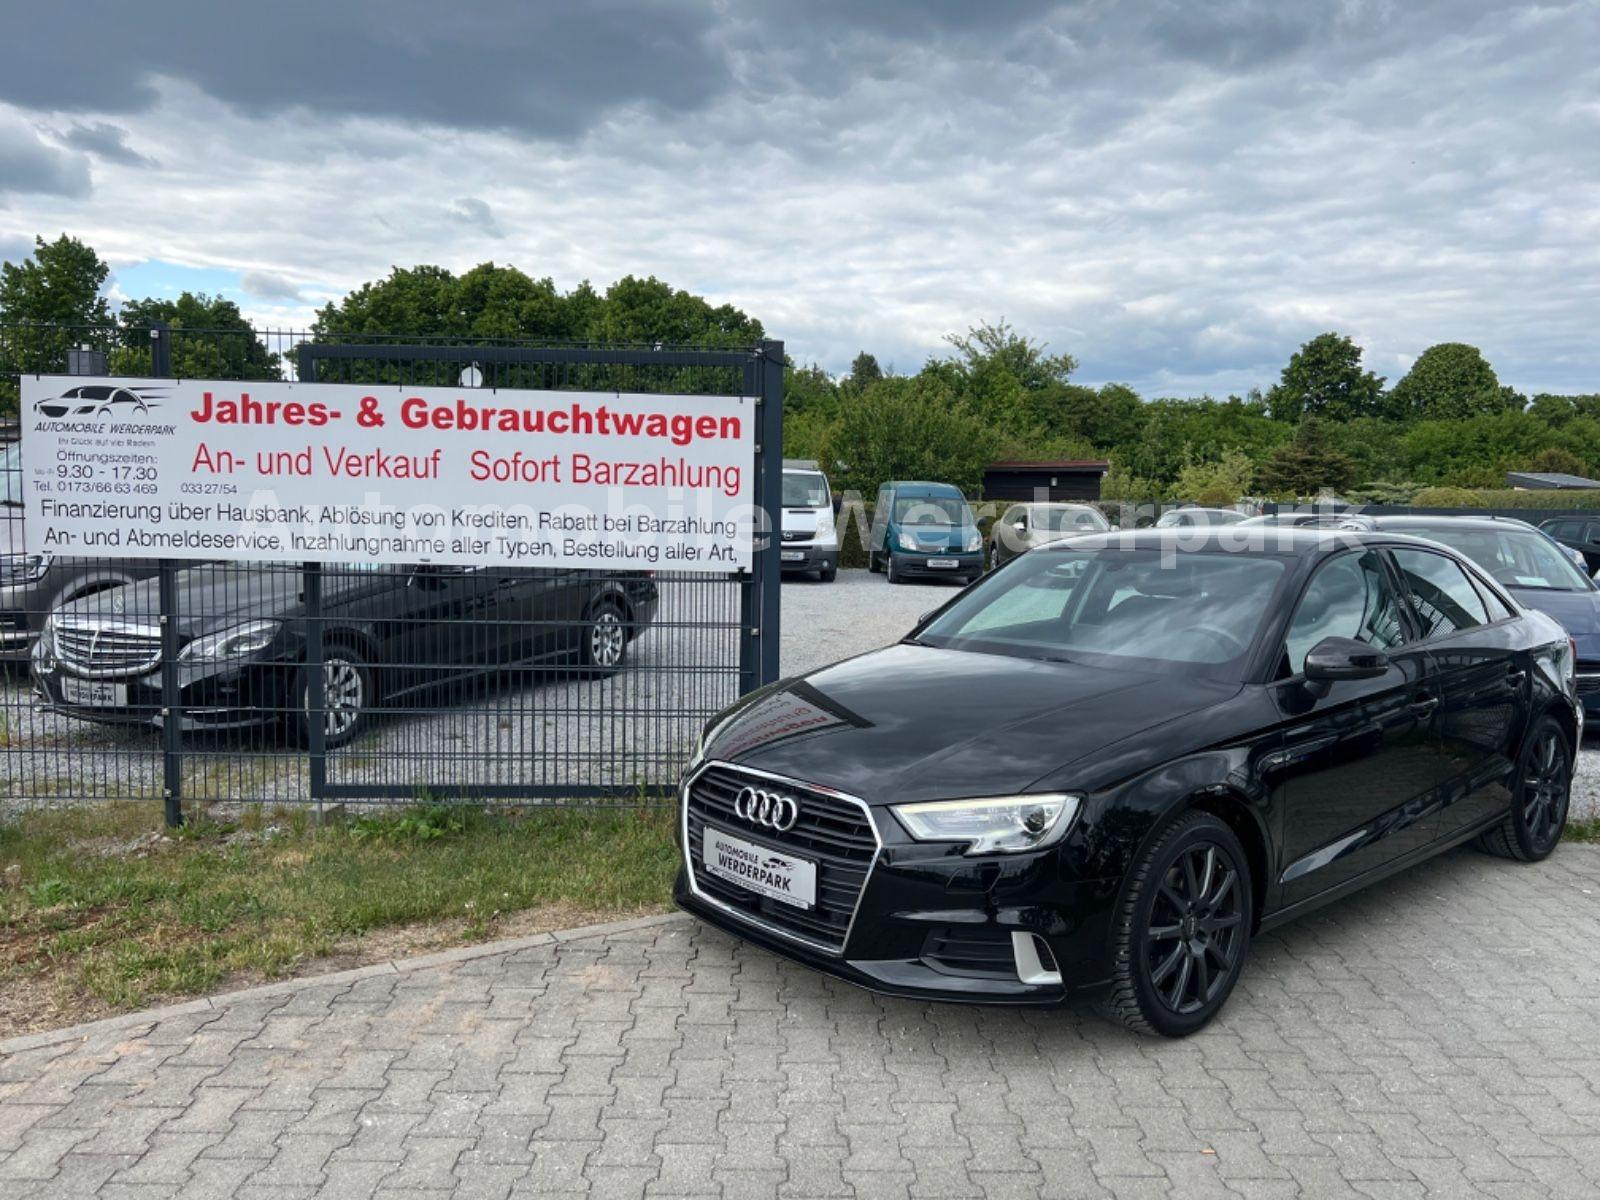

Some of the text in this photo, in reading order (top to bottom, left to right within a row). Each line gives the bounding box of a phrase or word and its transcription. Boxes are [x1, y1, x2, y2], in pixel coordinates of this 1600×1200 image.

[34, 421, 176, 435] AUTOMOBILE WERDERPARK
[190, 392, 741, 446] Jahres- & Gebrauchtwagen
[33, 481, 53, 491] Tel.
[57, 464, 93, 479] 9.30
[112, 466, 158, 480] 17.30
[191, 442, 741, 497] An- und Verkauf Sofort Barzahlung
[41, 499, 737, 539] Finanzierung über Hausbank, Ablösung von Krediten, Rabatt bei Barzahlung
[44, 527, 737, 564] An- und Abmeldeservice, Inzahlungnahme aller Typen, Bestellung aller Art,
[715, 841, 759, 864] AUTOMOBILE
[718, 853, 791, 892] WERDERPARK
